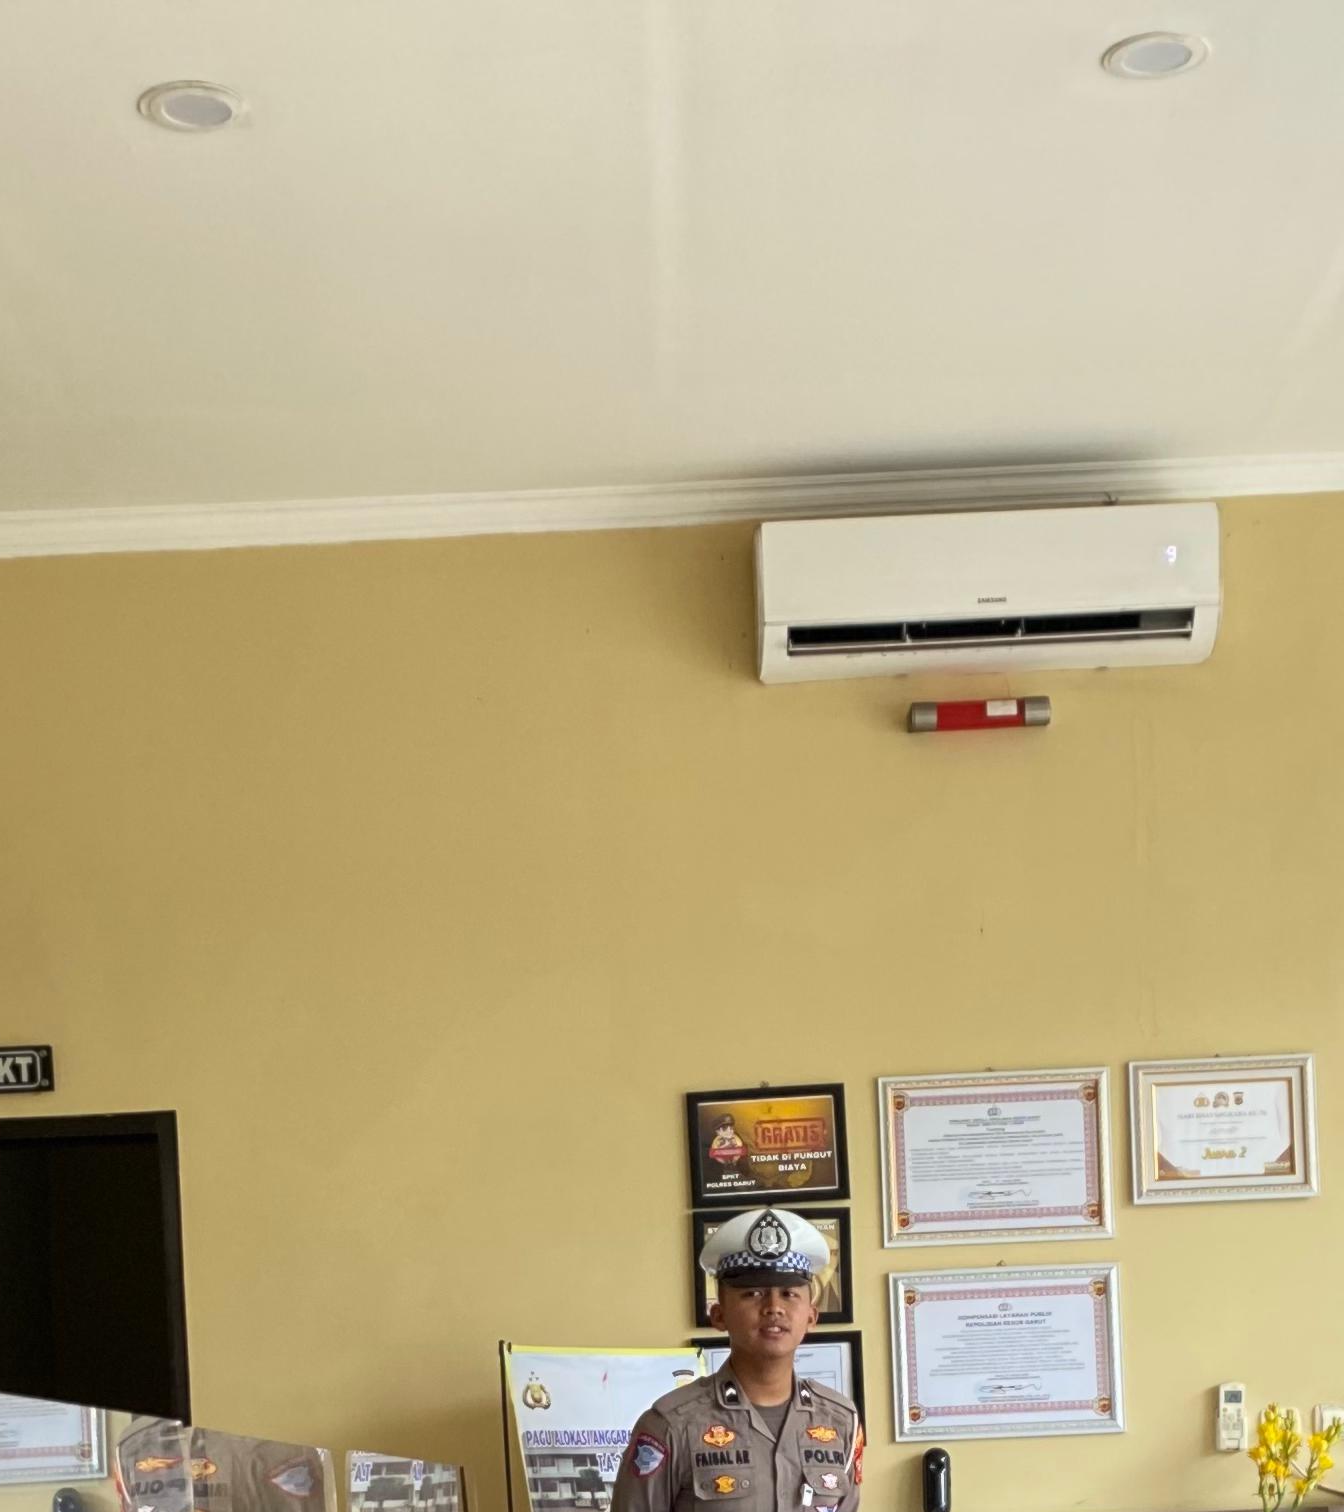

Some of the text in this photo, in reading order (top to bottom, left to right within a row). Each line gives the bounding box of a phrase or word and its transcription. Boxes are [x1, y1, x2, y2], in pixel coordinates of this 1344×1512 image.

[761, 1123, 820, 1145] GRATIS
[750, 1154, 780, 1163] TIDAK
[794, 1150, 833, 1160] PUNGUT
[778, 1163, 807, 1172] BIAYA
[525, 1430, 551, 1447] PAGU
[695, 1451, 733, 1467] FAISAL
[804, 1449, 845, 1466] POLRI
